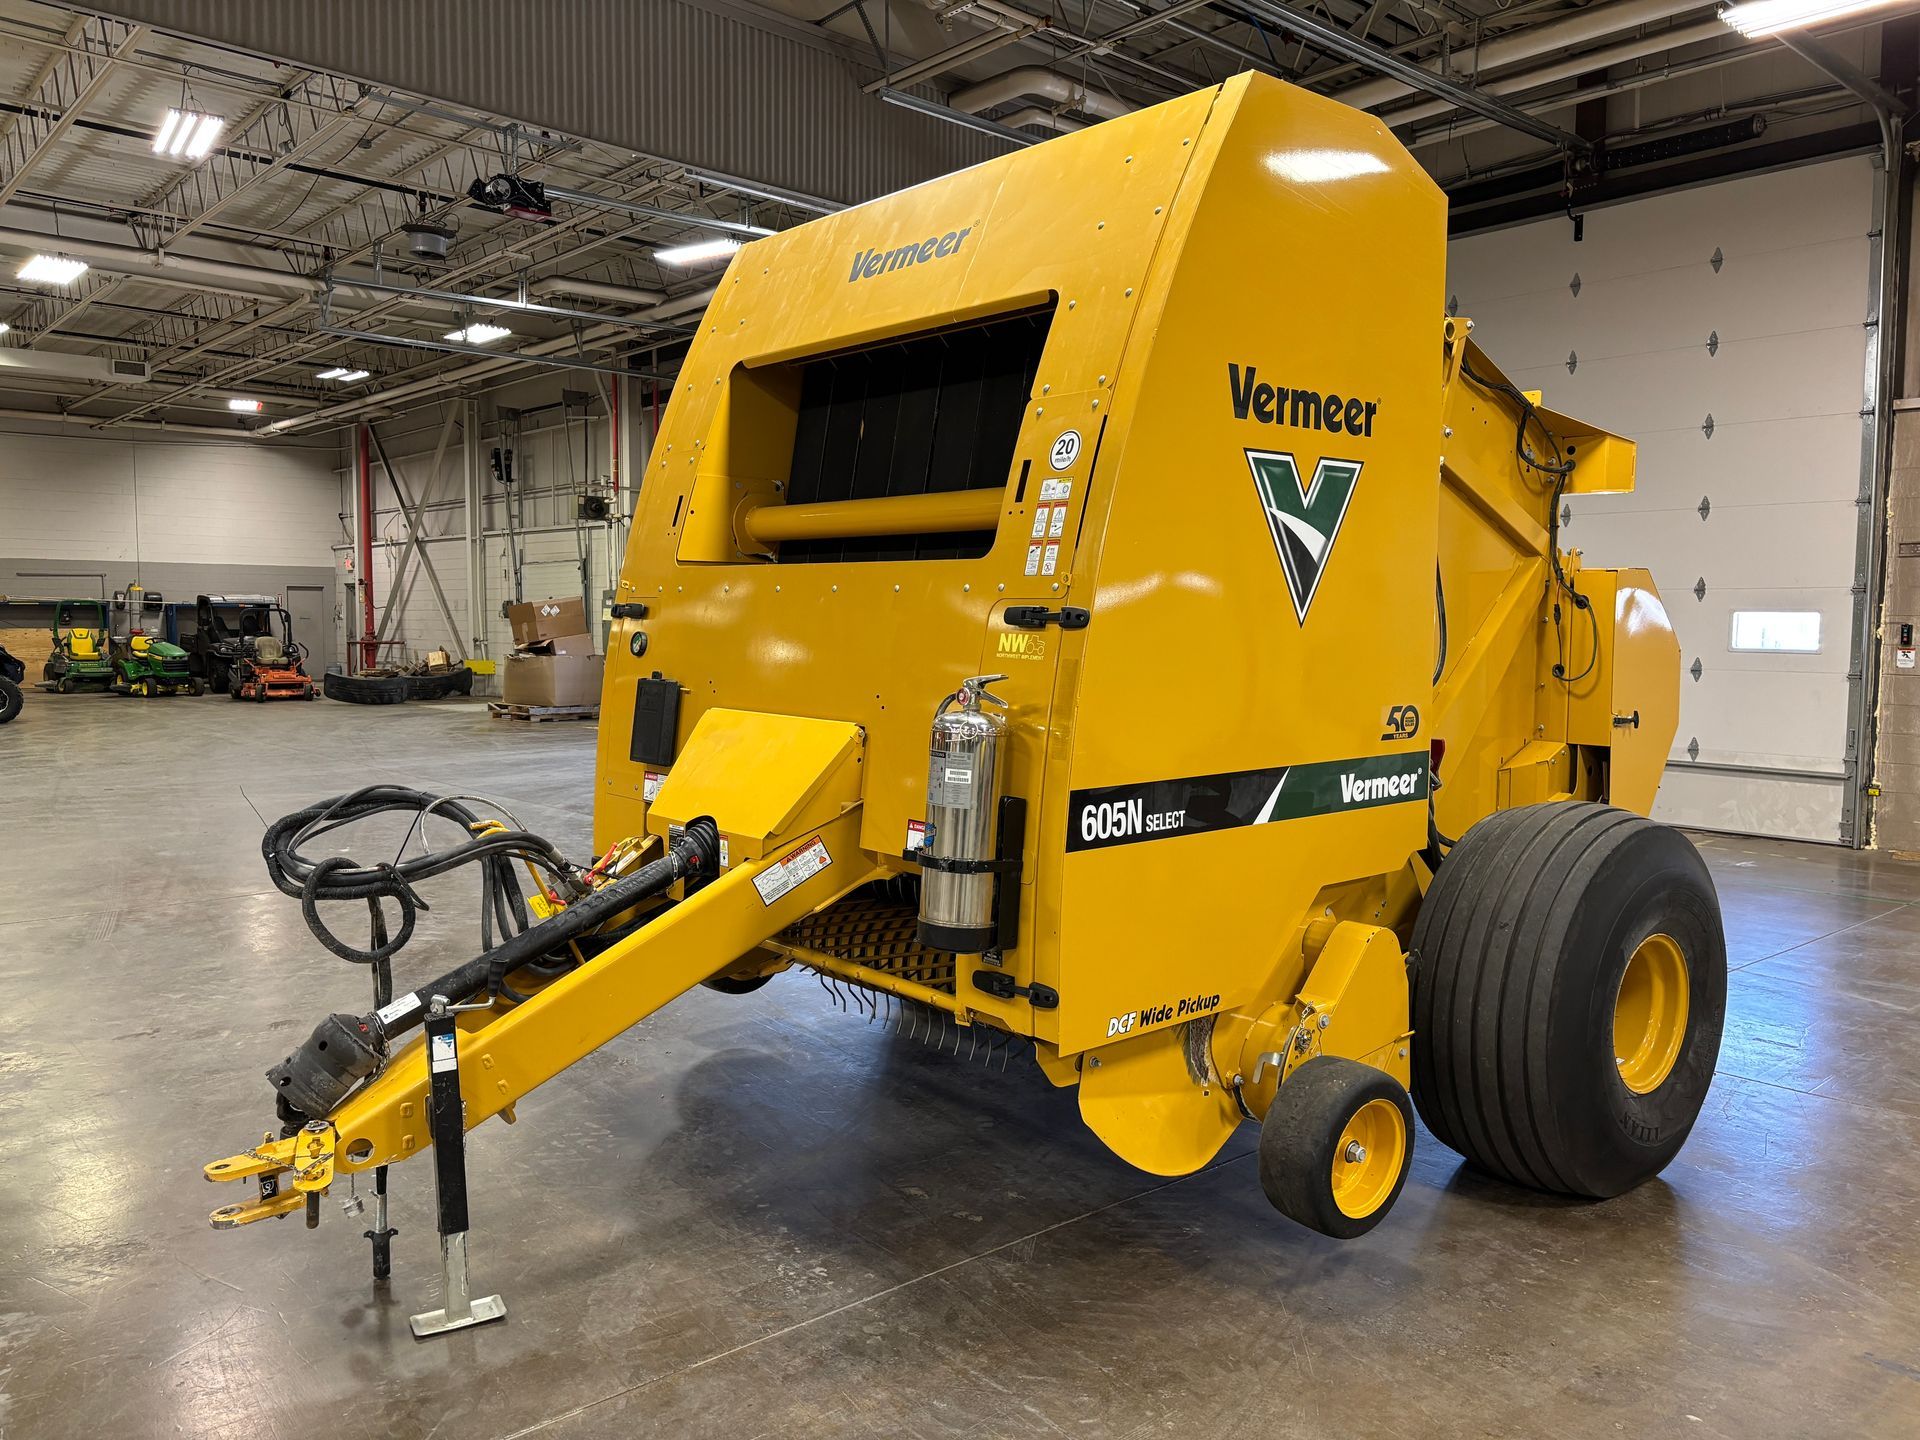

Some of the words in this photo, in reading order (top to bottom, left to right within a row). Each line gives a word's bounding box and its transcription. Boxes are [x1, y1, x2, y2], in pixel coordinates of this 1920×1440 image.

[848, 227, 972, 283] Vermeer
[1228, 363, 1377, 437] Vermeer
[1055, 438, 1075, 455] 20
[998, 633, 1029, 653] NW
[1340, 773, 1418, 804] Vermeer
[1081, 799, 1142, 842] 605N
[1146, 810, 1186, 832] SELECT
[1107, 1011, 1137, 1038] DCF
[1140, 1005, 1173, 1027] Wide
[1177, 994, 1220, 1017] Pickup
